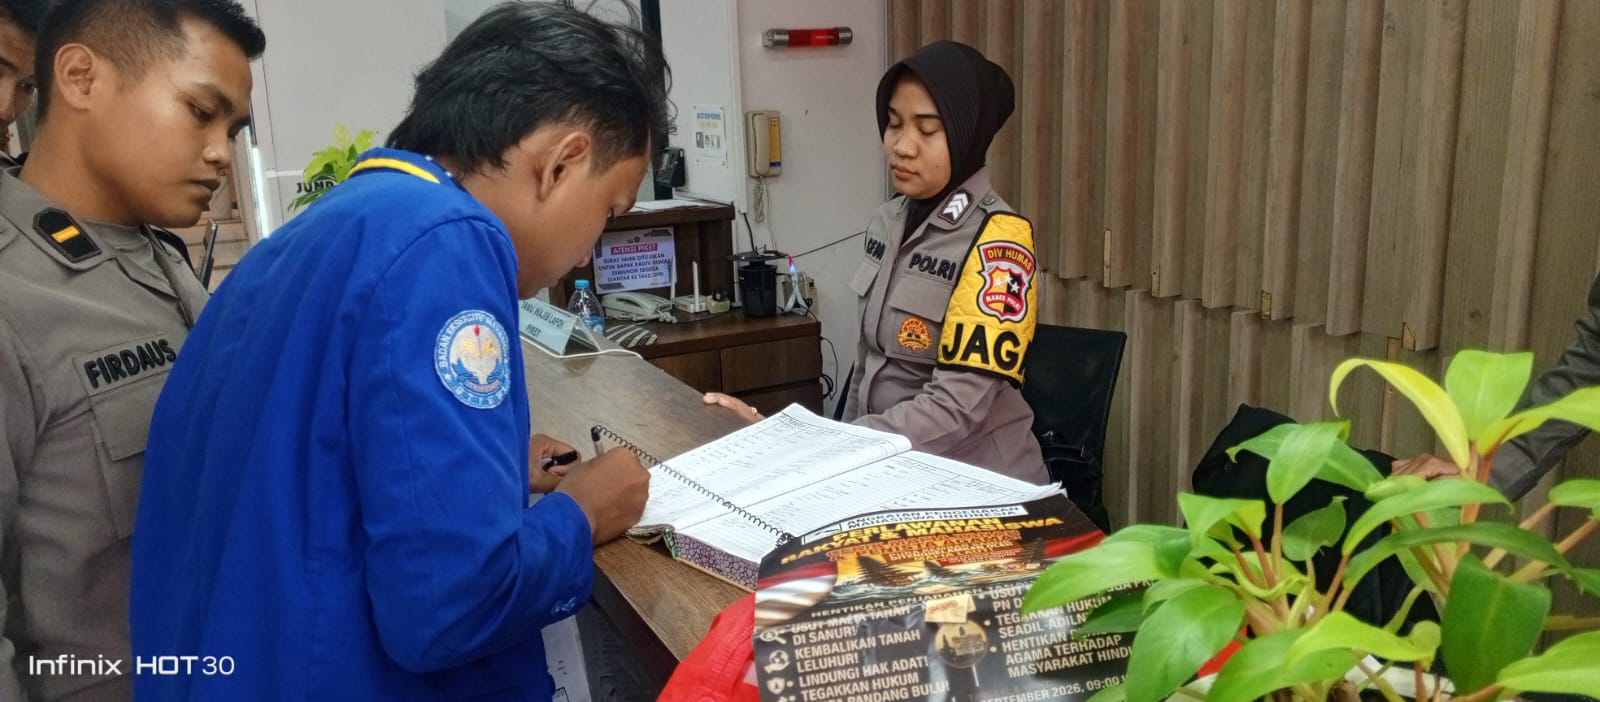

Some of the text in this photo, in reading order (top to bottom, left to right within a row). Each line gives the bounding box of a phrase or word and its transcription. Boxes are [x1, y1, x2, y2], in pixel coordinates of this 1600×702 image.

[613, 243, 657, 254] ATENSI PIKET
[987, 248, 1032, 270] DIV HUMAS
[909, 252, 956, 281] POLRI
[533, 307, 551, 322] WAJIB
[525, 323, 542, 338] PIKET
[941, 323, 1025, 376] JAG
[84, 339, 176, 389] FIRDAUS
[847, 511, 923, 525] ANGKATAN
[848, 510, 1019, 530] MAHASISWA INDONESIA
[781, 533, 872, 564] RAKYAT
[880, 529, 900, 540] &
[906, 517, 1064, 538] MAHASISWA
[832, 518, 1002, 543] PERLAWANAN
[990, 585, 1023, 600] USUT
[812, 601, 885, 618] HENTIKAN
[868, 604, 912, 621] TANAH
[993, 600, 1011, 612] PN
[793, 625, 858, 646] DI SANUR!
[794, 628, 921, 661] KEMBALIKAN TANAH
[1002, 631, 1068, 653] HENTIKAN
[1005, 644, 1054, 667] AGAMA
[1056, 633, 1123, 659] TERHADAP
[796, 652, 860, 674] LELUHUR!
[798, 655, 930, 688] LINDUNGI HAK ADAT!
[1007, 653, 1094, 680] MASYARAKAT
[800, 671, 920, 702] TEGAKKAN HUKUM
[850, 679, 951, 702] PANDANG BULU!
[981, 689, 1050, 702] TEMBER
[1051, 681, 1085, 698] 2026,
[1087, 674, 1121, 690] 09:00
